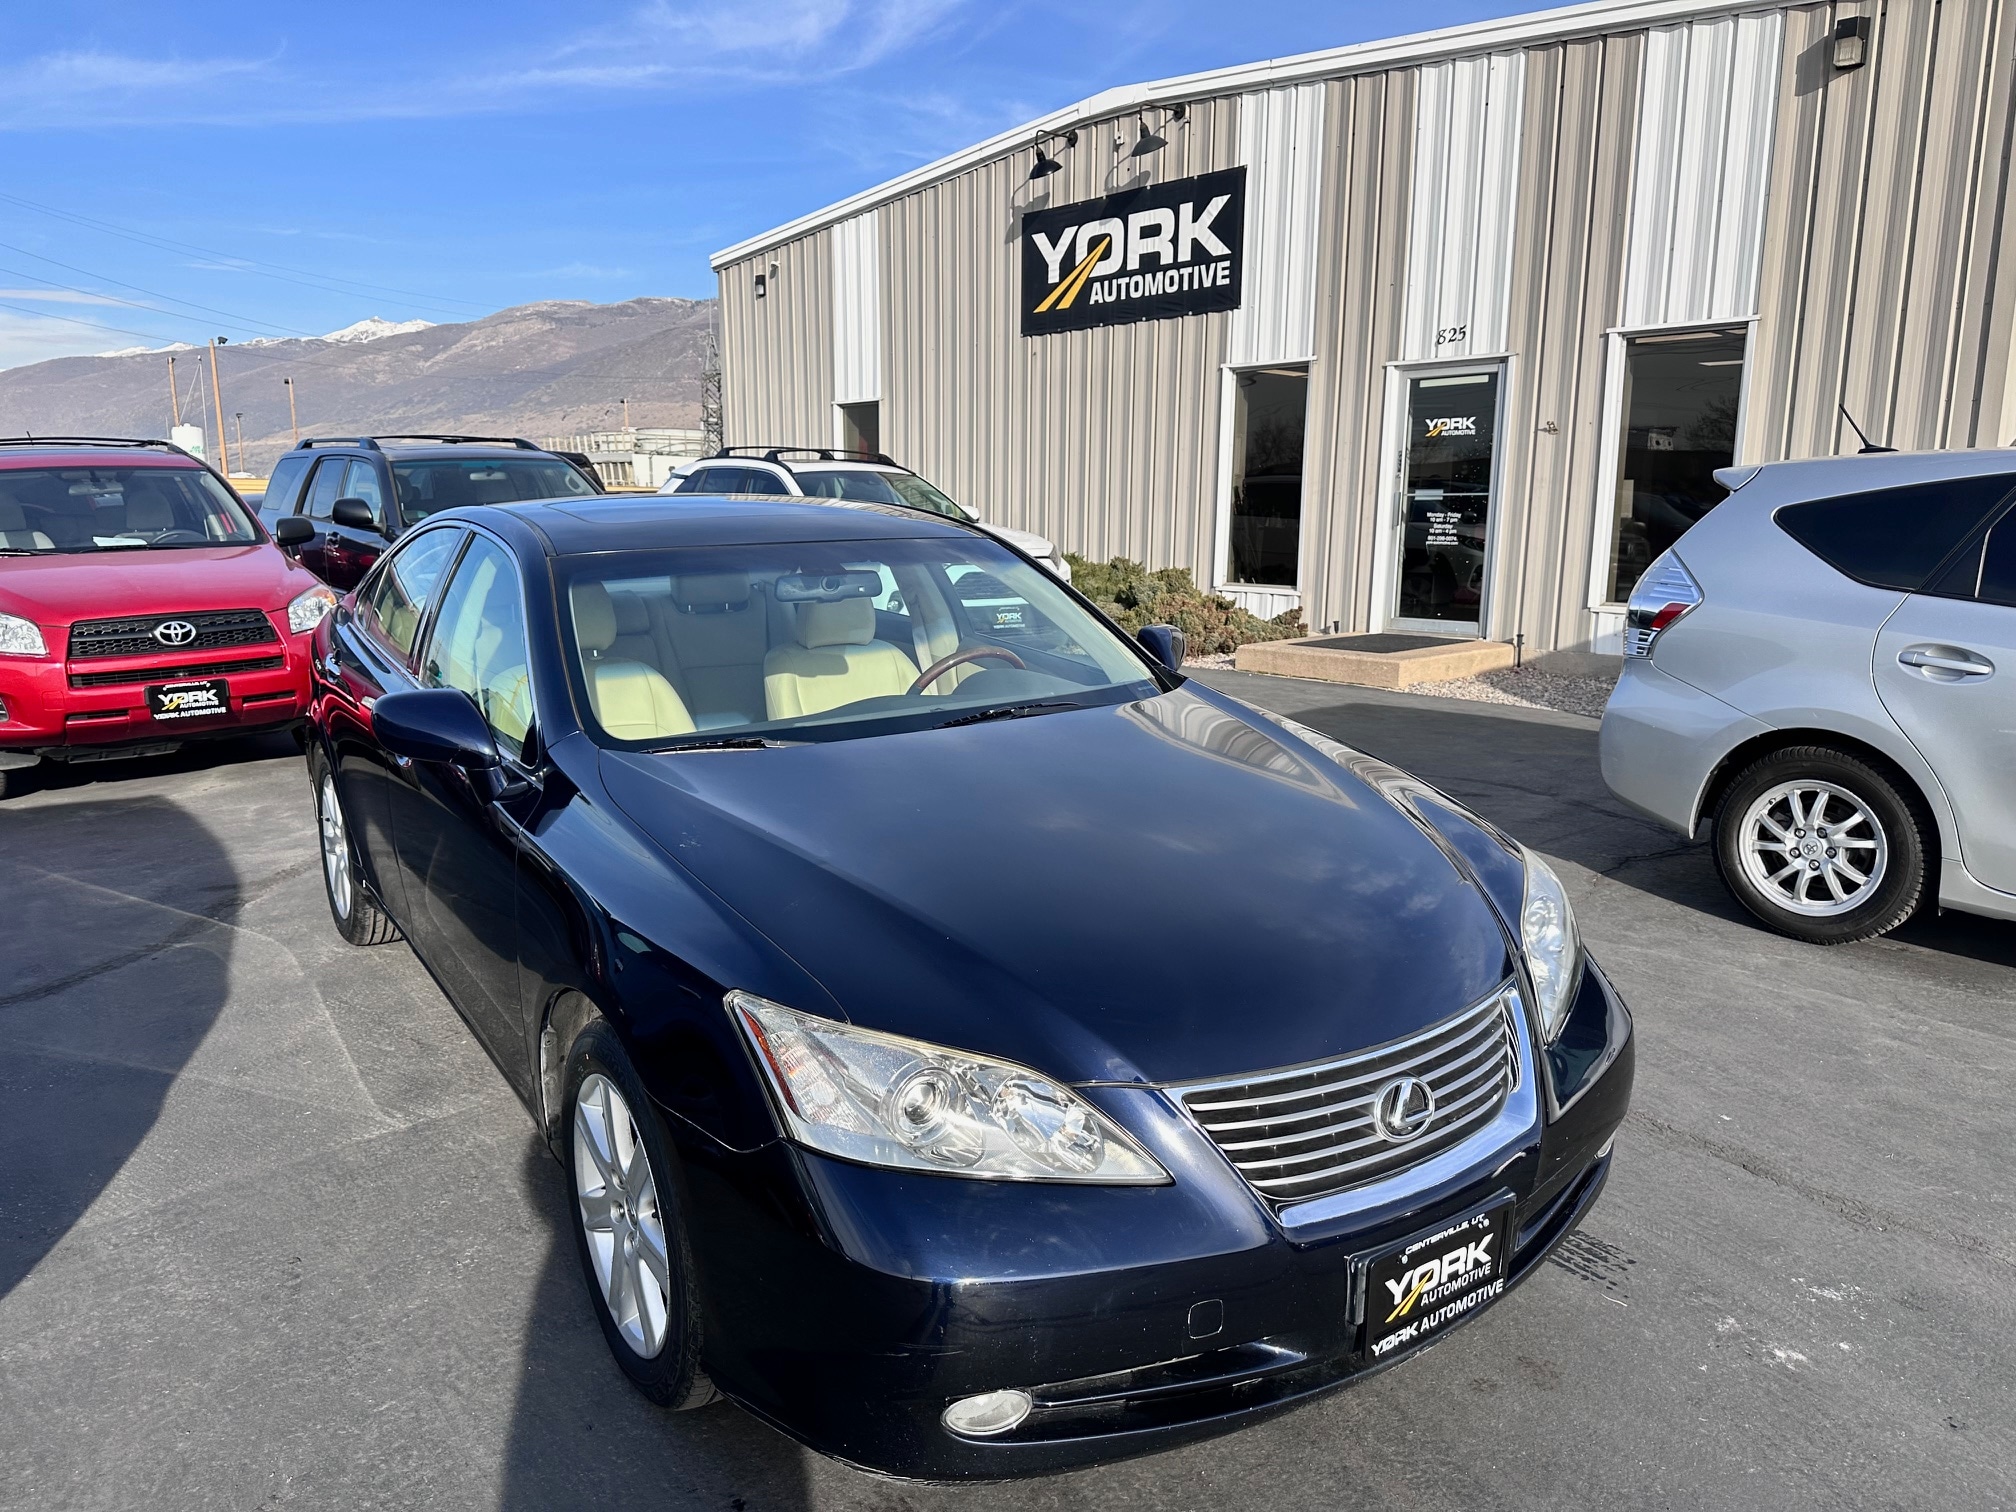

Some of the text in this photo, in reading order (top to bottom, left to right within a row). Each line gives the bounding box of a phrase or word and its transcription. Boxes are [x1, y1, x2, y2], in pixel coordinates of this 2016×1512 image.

[1031, 193, 1232, 284] YORK
[1089, 260, 1231, 305] AUTOMOTIVE
[1437, 324, 1467, 345] 825
[1425, 416, 1476, 431] YORK
[157, 689, 218, 706] YORK
[180, 700, 219, 709] AUTOMOTIVE
[180, 706, 227, 717] AUTOMOTIVE
[1471, 1213, 1485, 1225] UT
[1384, 1233, 1494, 1306] YORK
[1420, 1262, 1492, 1307] AUTOMOTIVE
[1371, 1278, 1504, 1357] YORK AUTOMOTIVE
